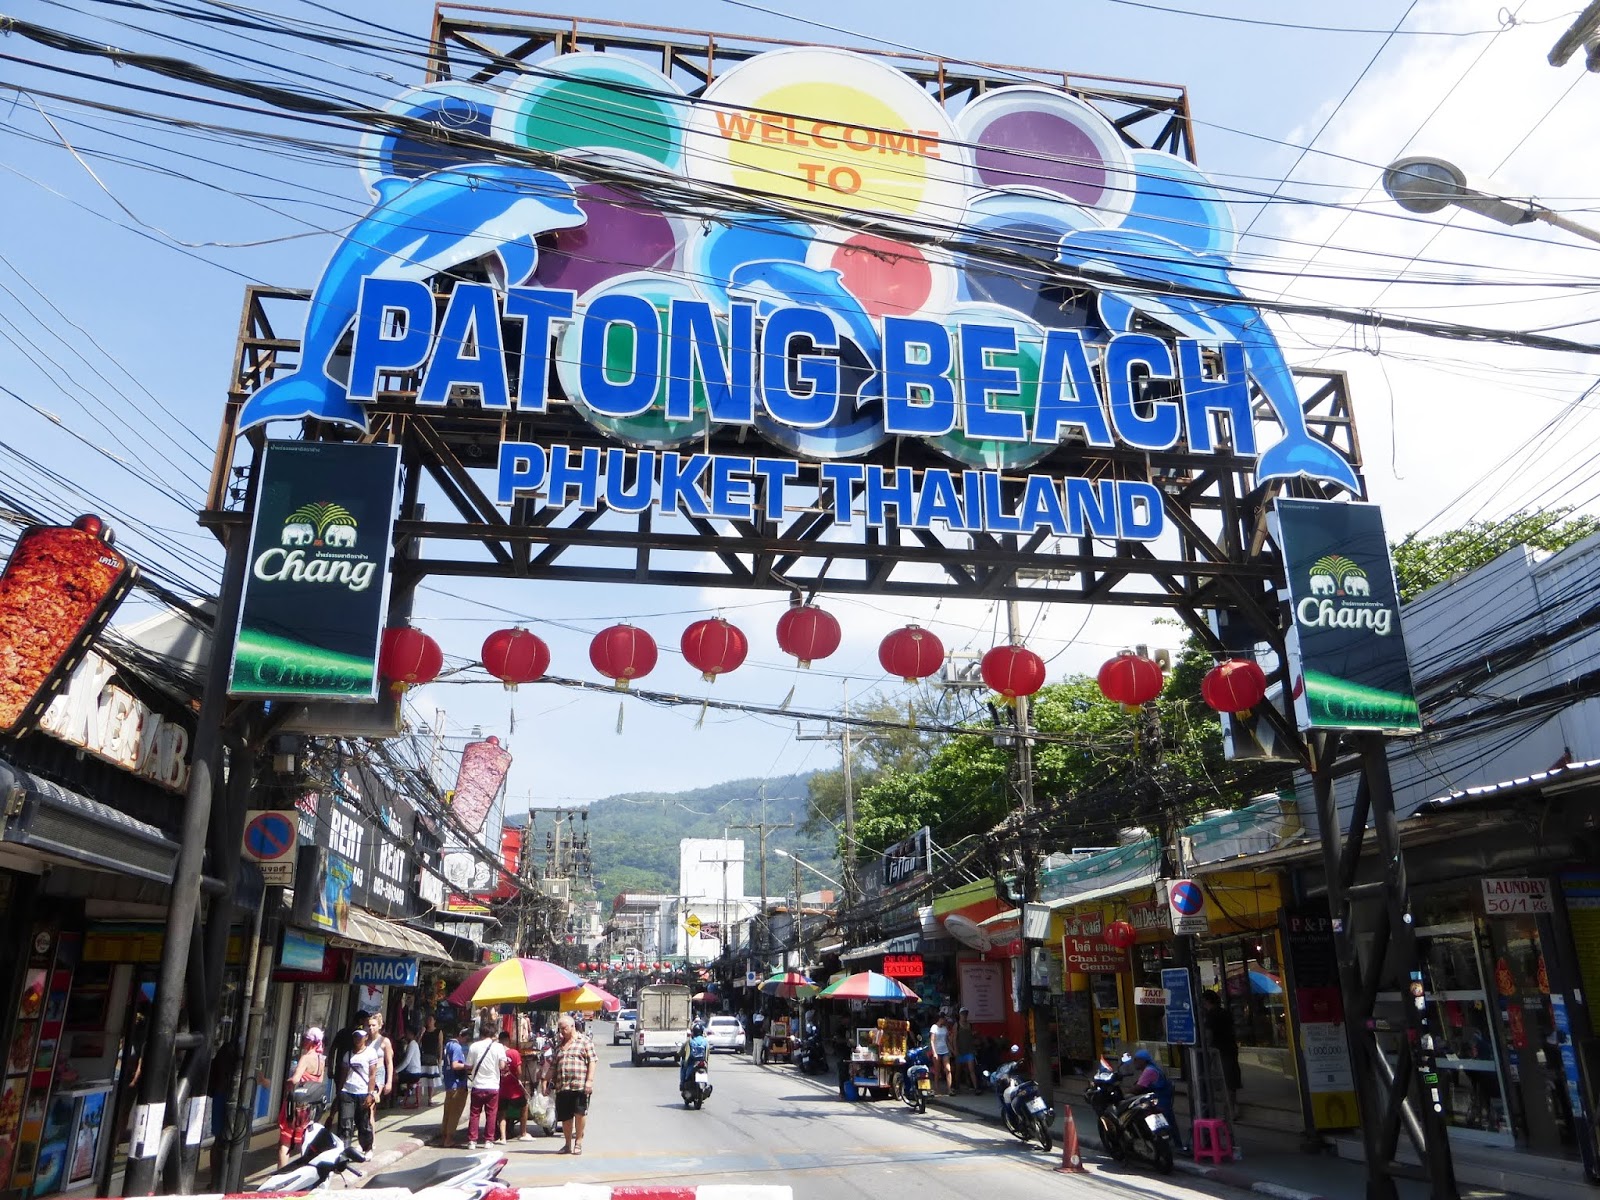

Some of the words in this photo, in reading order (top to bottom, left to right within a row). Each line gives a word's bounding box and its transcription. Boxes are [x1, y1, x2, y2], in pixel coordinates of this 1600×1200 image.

[715, 110, 941, 160] WELCOME
[797, 161, 862, 195] TO
[346, 277, 840, 429] PATONG
[880, 316, 1257, 457] BEACH
[495, 441, 797, 523] PHUKET
[822, 461, 1166, 541] THAILAND
[254, 547, 377, 592] Chang
[1297, 596, 1392, 636] Chang
[328, 808, 364, 863] RENT
[378, 837, 406, 883] RENT
[1486, 880, 1547, 894] LAUNDRY
[1488, 898, 1527, 913] 50/1
[1291, 917, 1300, 932] P
[353, 962, 415, 980] ARMACY
[885, 964, 922, 973] TATTOO
[1068, 955, 1098, 963] Chai
[1101, 955, 1126, 963] Dee
[1080, 963, 1116, 971] Gems
[1144, 989, 1162, 997] TAXI
